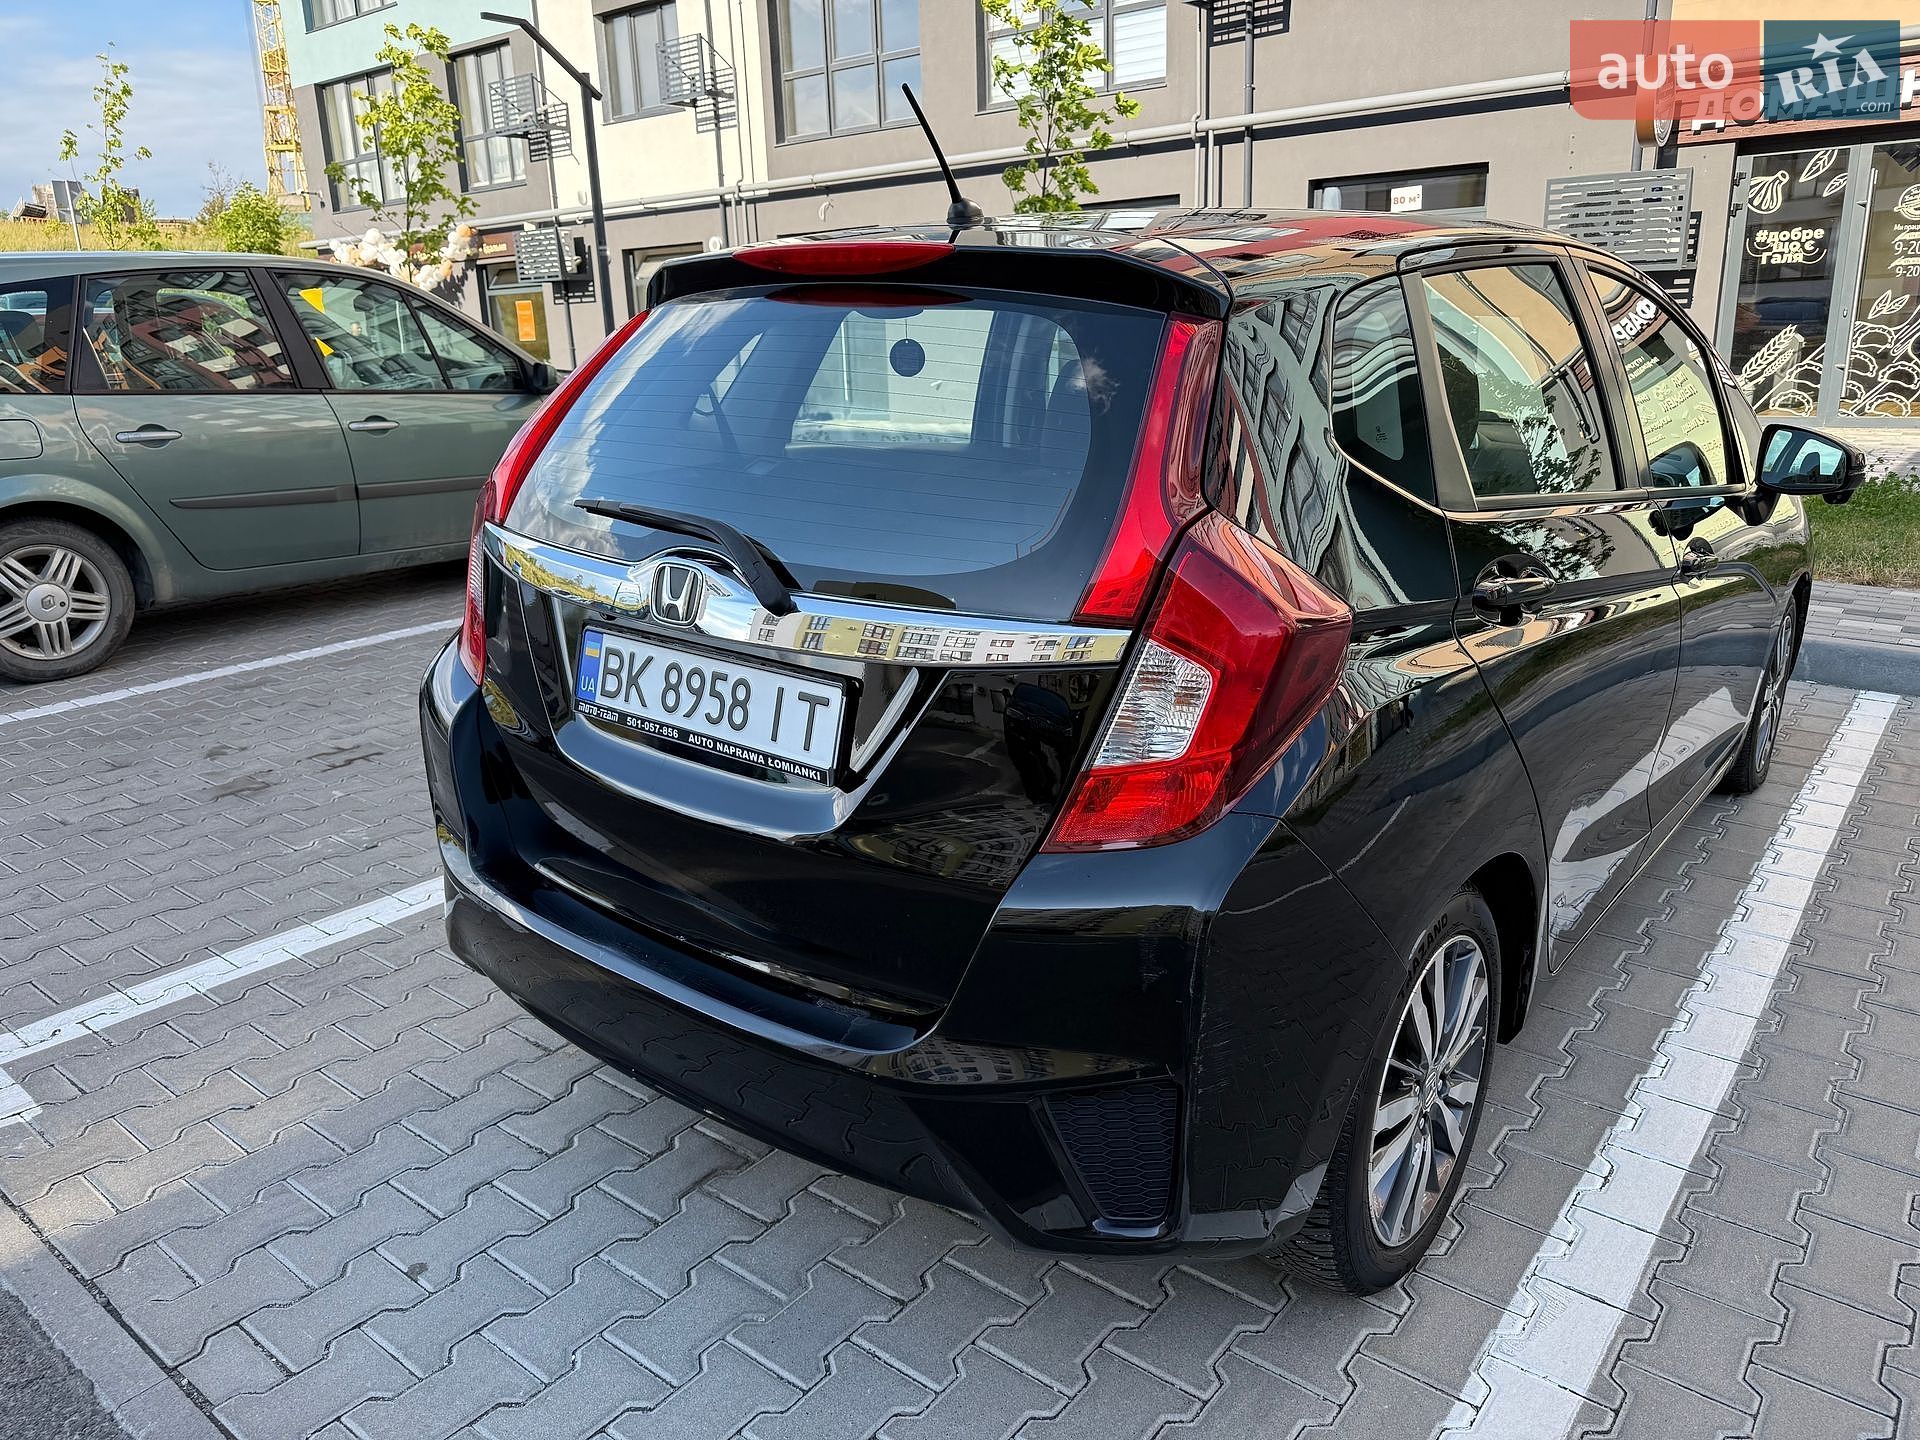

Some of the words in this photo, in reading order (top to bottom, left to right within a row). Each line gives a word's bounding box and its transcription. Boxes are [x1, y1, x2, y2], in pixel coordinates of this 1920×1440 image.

[1755, 227, 1825, 243] #добре
[580, 675, 596, 693] UA
[600, 647, 653, 707] BK
[661, 662, 751, 731] 8958
[771, 687, 830, 751] IT
[626, 716, 679, 739] 501-057-856
[688, 733, 714, 750] AUTO
[716, 741, 765, 765] NAPRAWA
[768, 756, 821, 781] ŁOMIANKI
